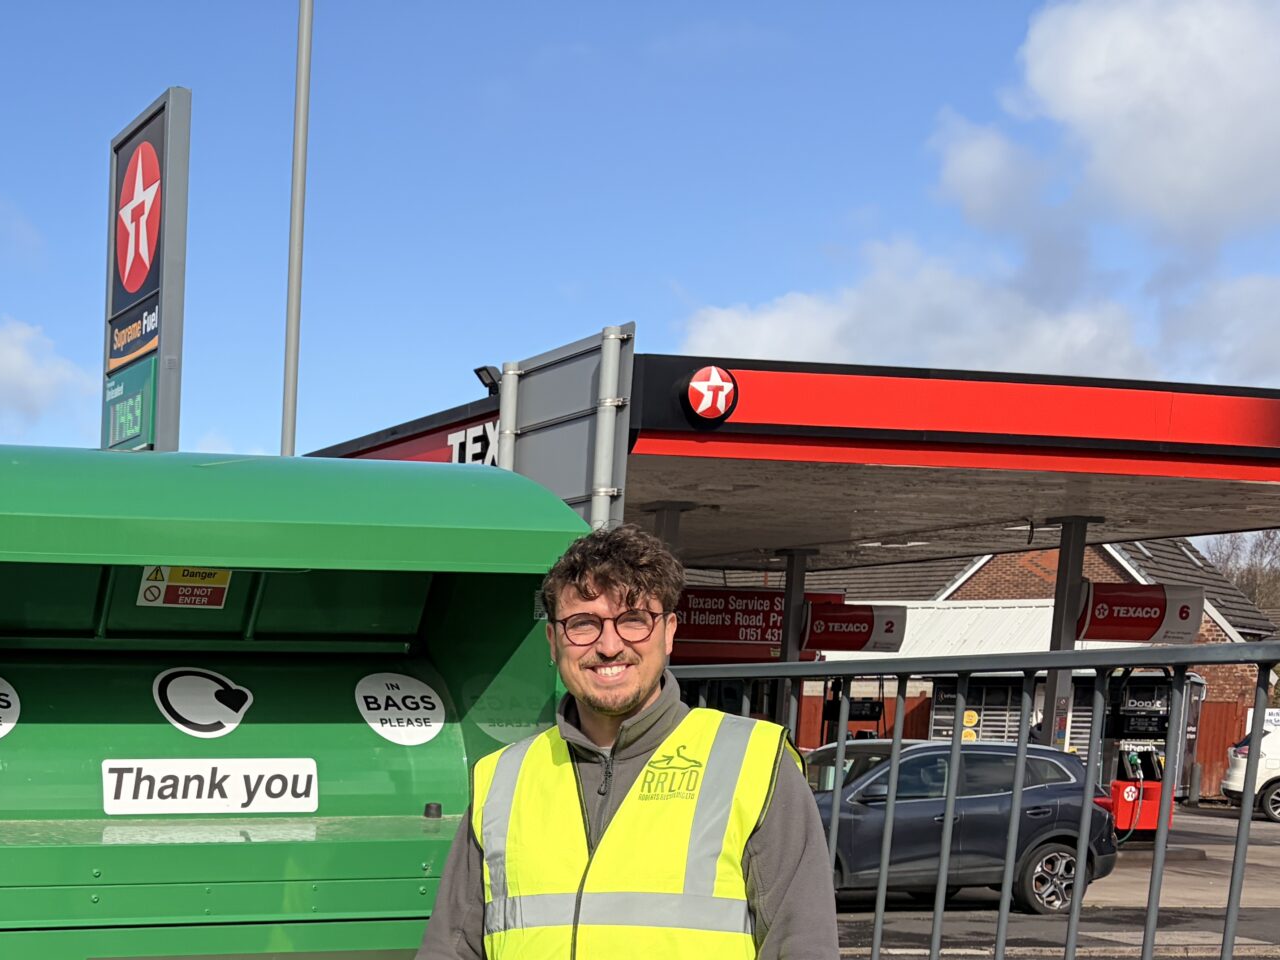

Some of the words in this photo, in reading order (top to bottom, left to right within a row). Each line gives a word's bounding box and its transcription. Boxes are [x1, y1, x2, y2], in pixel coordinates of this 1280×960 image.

[113, 320, 141, 351] Supreme
[142, 305, 158, 335] Fuel
[182, 569, 217, 580] Danger
[178, 587, 191, 595] DO
[193, 587, 213, 596] NOT
[178, 596, 208, 605] ENTER
[687, 594, 725, 610] Texaco
[728, 595, 771, 611] Service
[1112, 606, 1160, 618] TEXACO
[1178, 605, 1191, 620] 6
[690, 611, 731, 626] Helen's
[734, 612, 766, 628] Road,
[827, 622, 869, 632] TEXACO
[884, 620, 895, 633] 2
[739, 628, 761, 641] 0151
[765, 629, 783, 641] 431
[385, 682, 401, 691] IN
[363, 695, 436, 711] BAGS
[379, 717, 432, 728] PLEASE
[107, 766, 231, 800] Thank
[240, 773, 313, 808] you
[640, 769, 699, 794] RRLTD
